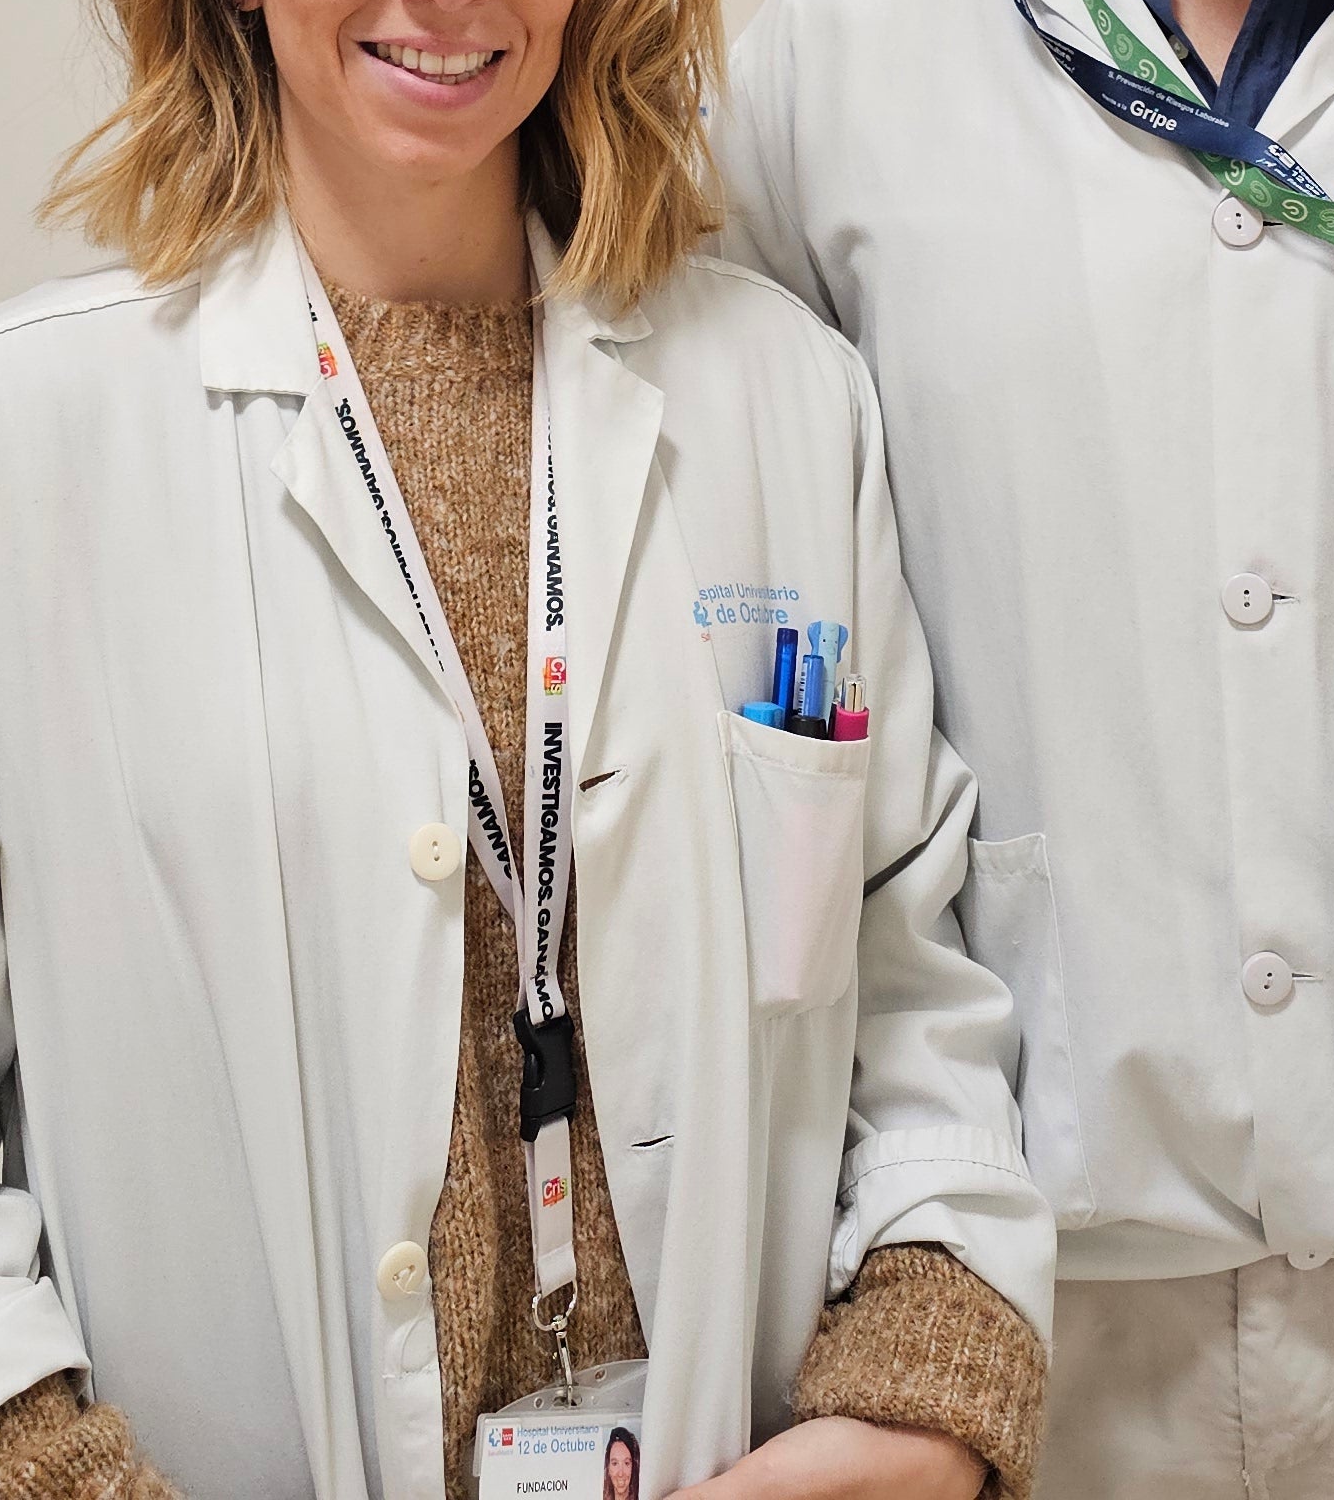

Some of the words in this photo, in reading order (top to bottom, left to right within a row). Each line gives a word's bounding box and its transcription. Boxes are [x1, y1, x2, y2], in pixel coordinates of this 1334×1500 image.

[1130, 100, 1177, 131] Gripe
[546, 515, 564, 631] GANAMOS.
[699, 583, 735, 603] spital
[716, 603, 737, 624] de
[549, 658, 566, 693] Cris
[538, 722, 563, 907] INVESTIGAMOS.
[535, 908, 554, 1021] GANAMO
[544, 1177, 565, 1199] Cris
[517, 1427, 549, 1438] Hospital
[551, 1425, 599, 1436] Universitario
[518, 1441, 530, 1455] 12
[533, 1440, 547, 1454] de
[551, 1438, 595, 1451] Octubre
[517, 1480, 567, 1493] FUNDACION
